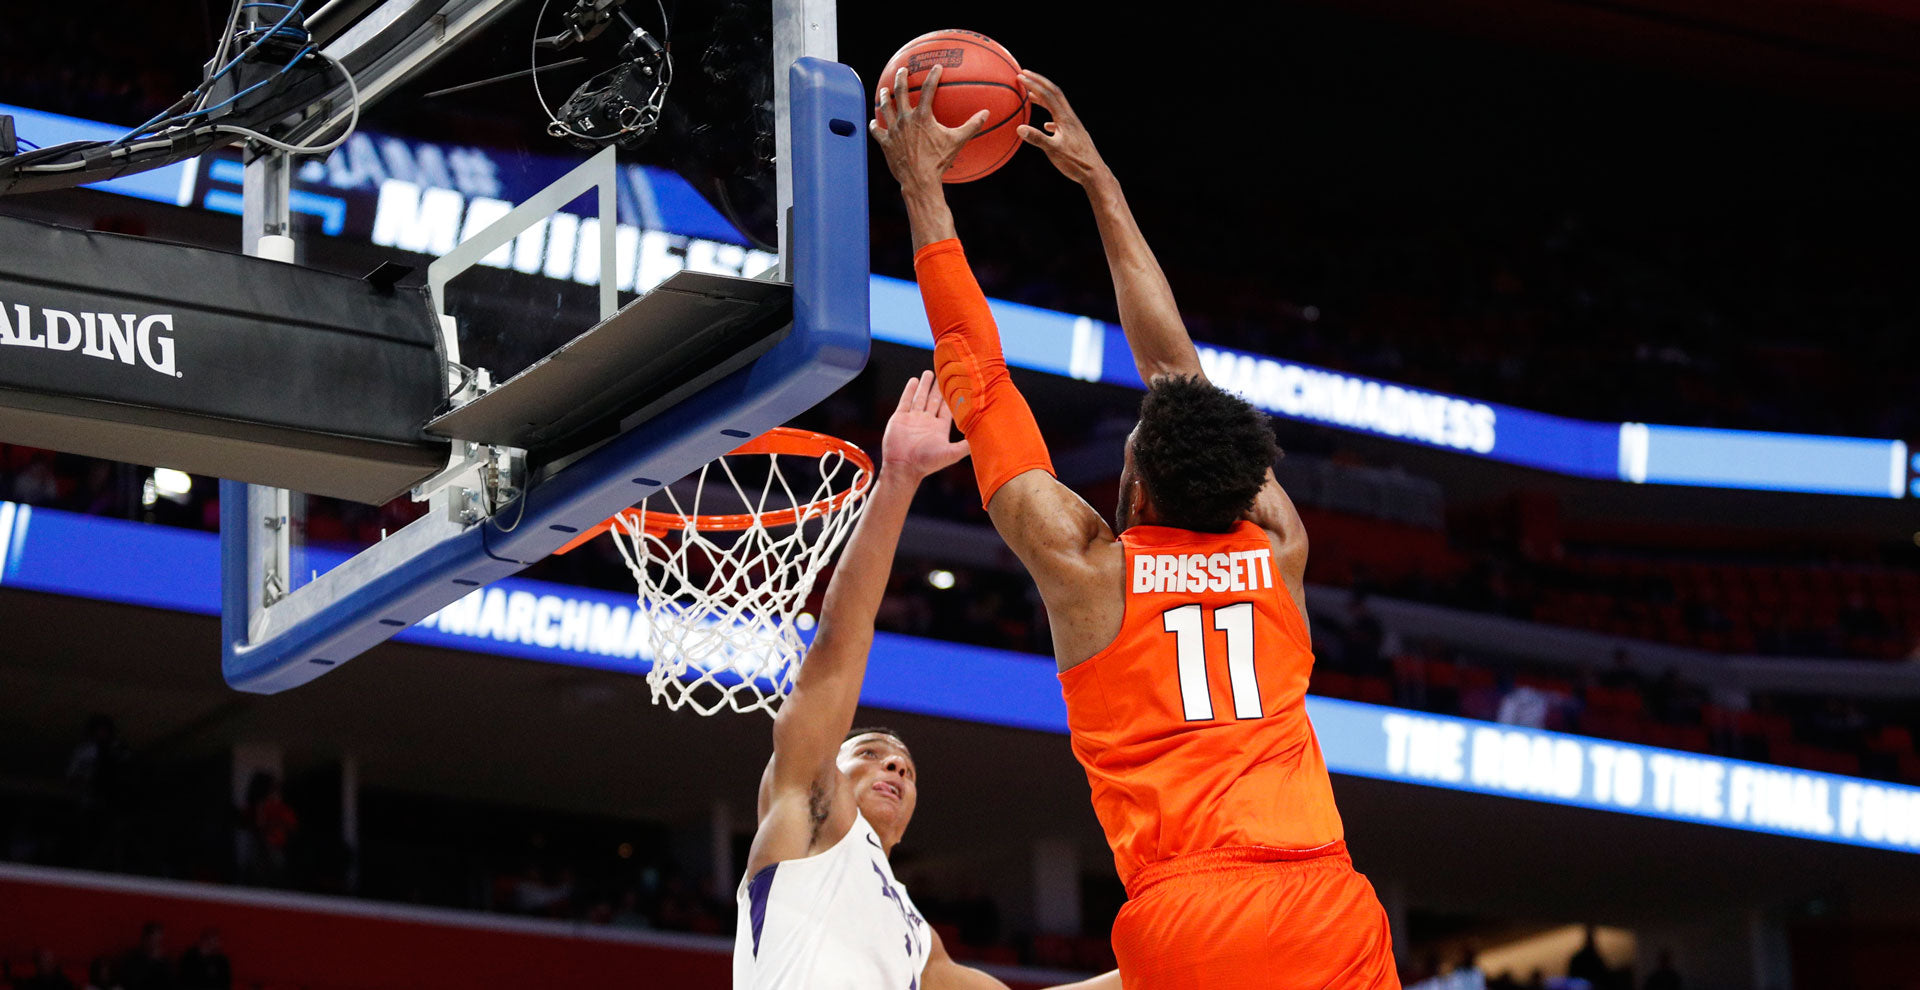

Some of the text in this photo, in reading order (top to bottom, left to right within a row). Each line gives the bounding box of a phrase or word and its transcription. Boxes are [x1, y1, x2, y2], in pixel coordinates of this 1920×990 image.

[1133, 549, 1273, 593] BRISSETT
[1163, 601, 1264, 721] 11
[1382, 713, 1466, 782] THE
[1471, 727, 1583, 798] ROAD
[1590, 744, 1643, 806] TO
[1650, 753, 1725, 818] THE
[1730, 765, 1834, 834] FINAL
